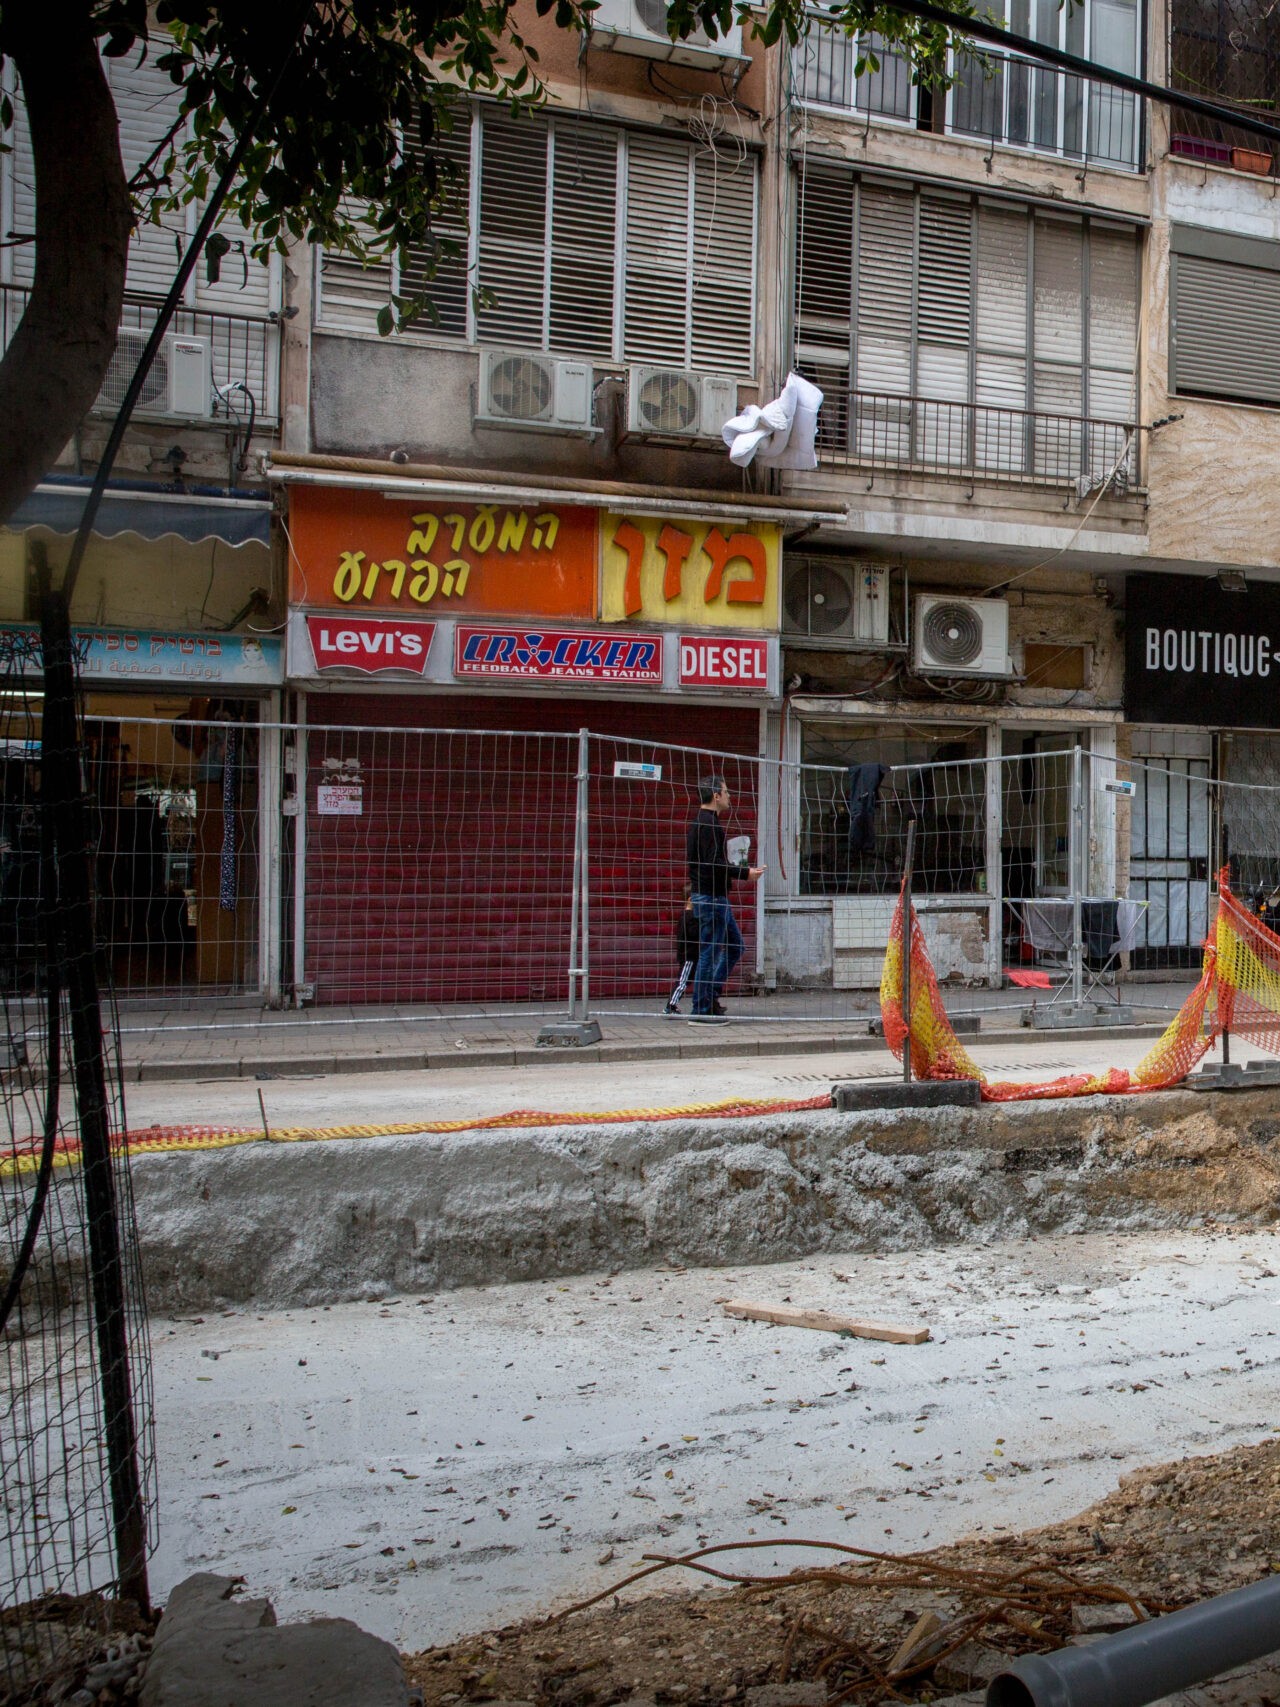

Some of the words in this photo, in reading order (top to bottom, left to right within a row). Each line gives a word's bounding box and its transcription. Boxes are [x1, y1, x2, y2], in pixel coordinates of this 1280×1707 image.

[406, 504, 560, 554] המערב
[333, 550, 471, 603] הפרוע
[602, 519, 767, 616] מזן
[150, 636, 222, 657] בוטיק
[463, 663, 540, 674] FEEDBACK
[548, 667, 594, 676] JEANS
[602, 669, 660, 679] STATION
[681, 645, 767, 679] DIESEL
[1146, 628, 1271, 678] BOUTIQUE
